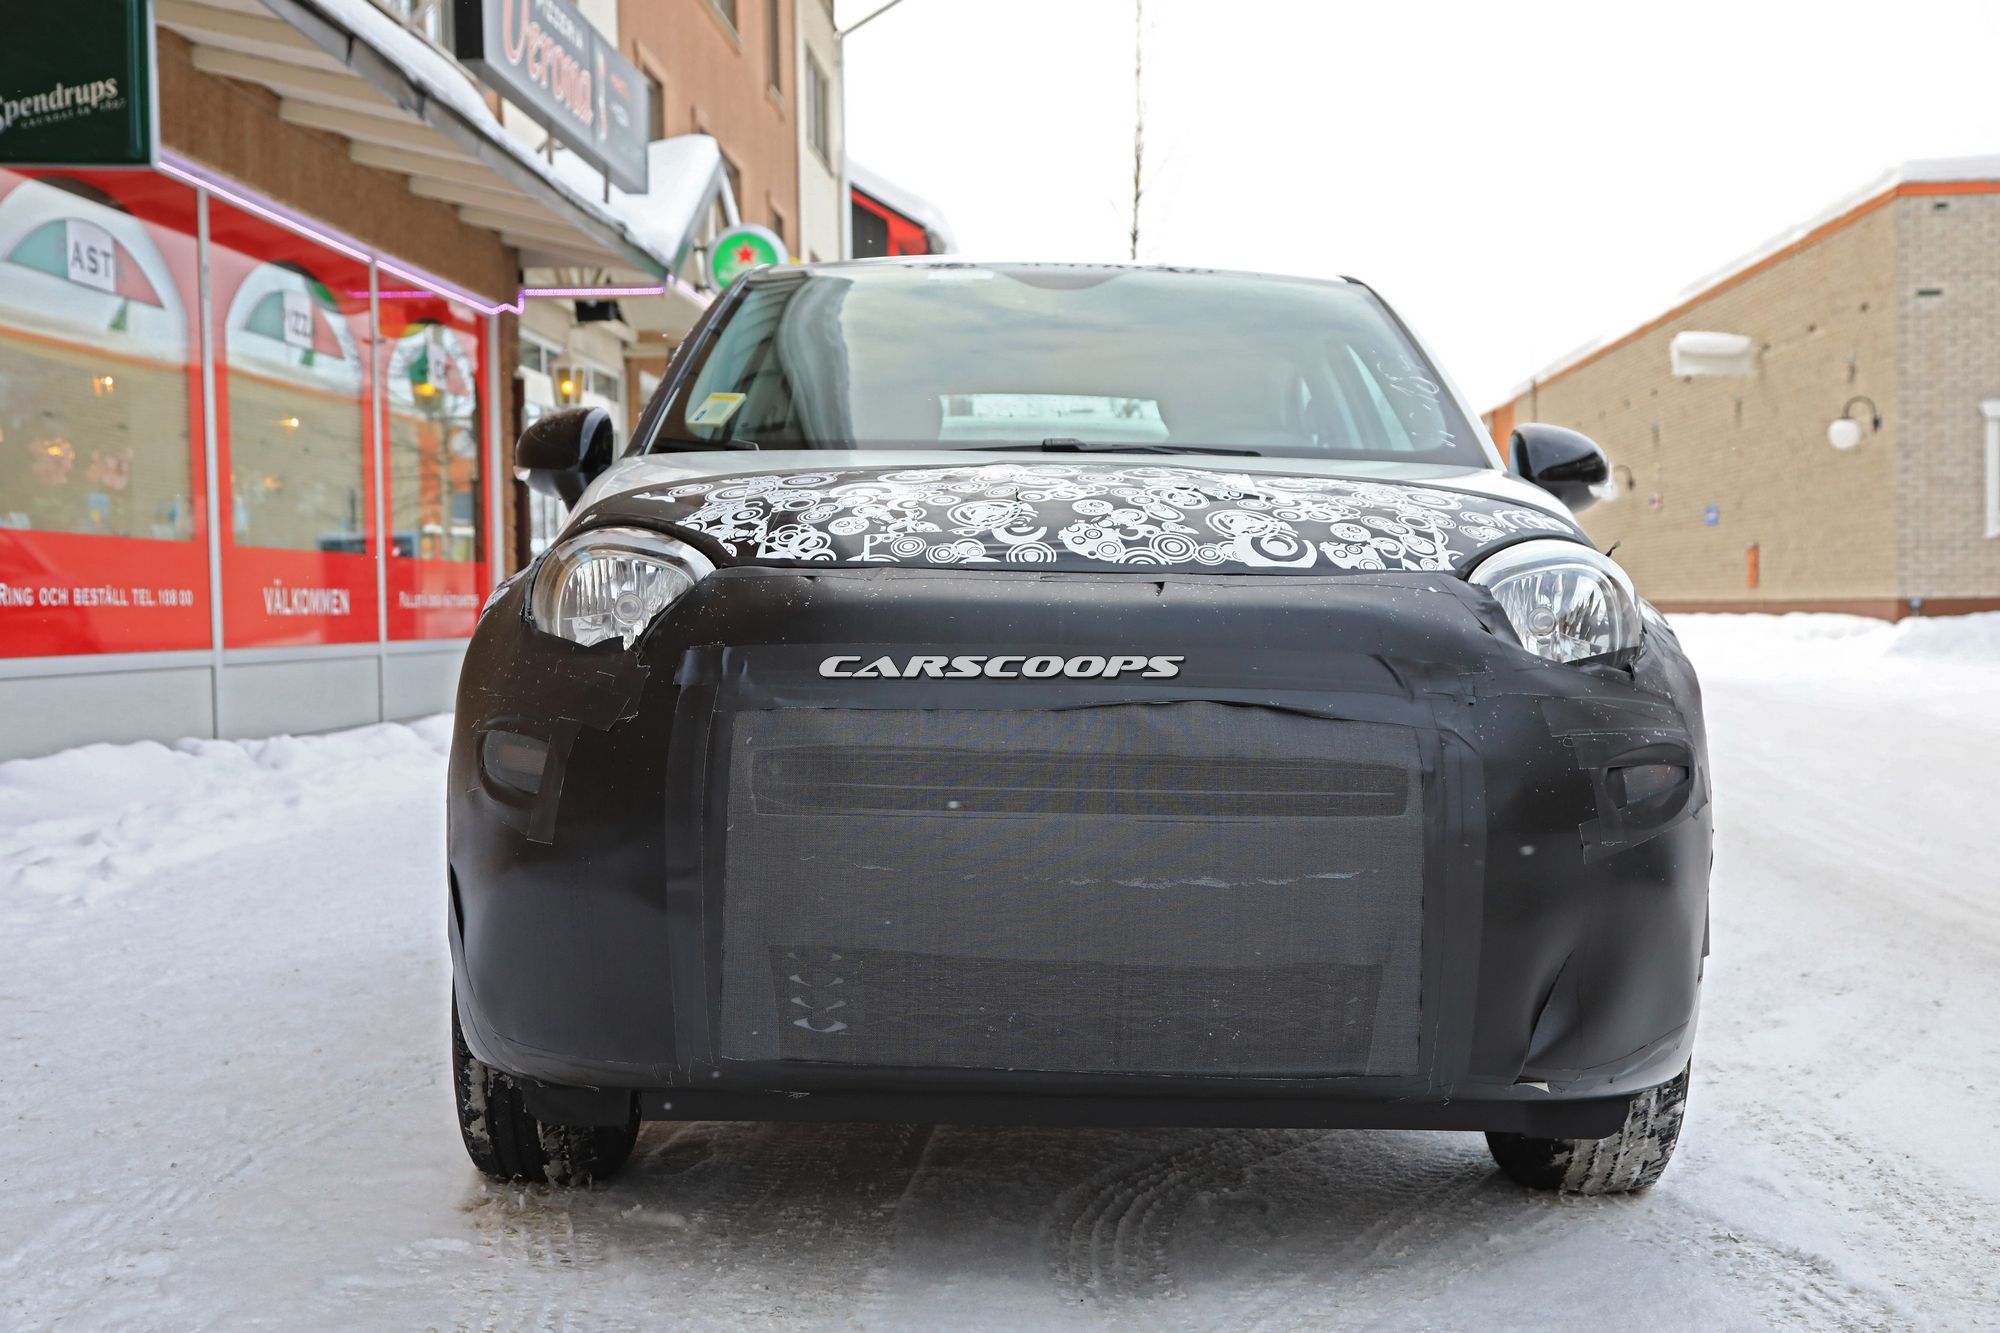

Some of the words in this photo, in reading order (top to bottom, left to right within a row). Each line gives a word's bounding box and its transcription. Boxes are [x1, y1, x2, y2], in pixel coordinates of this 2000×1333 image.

[38, 586, 70, 607] OCH
[73, 584, 129, 607] BESTÄLL
[262, 578, 351, 616] VÄLKOMMEN
